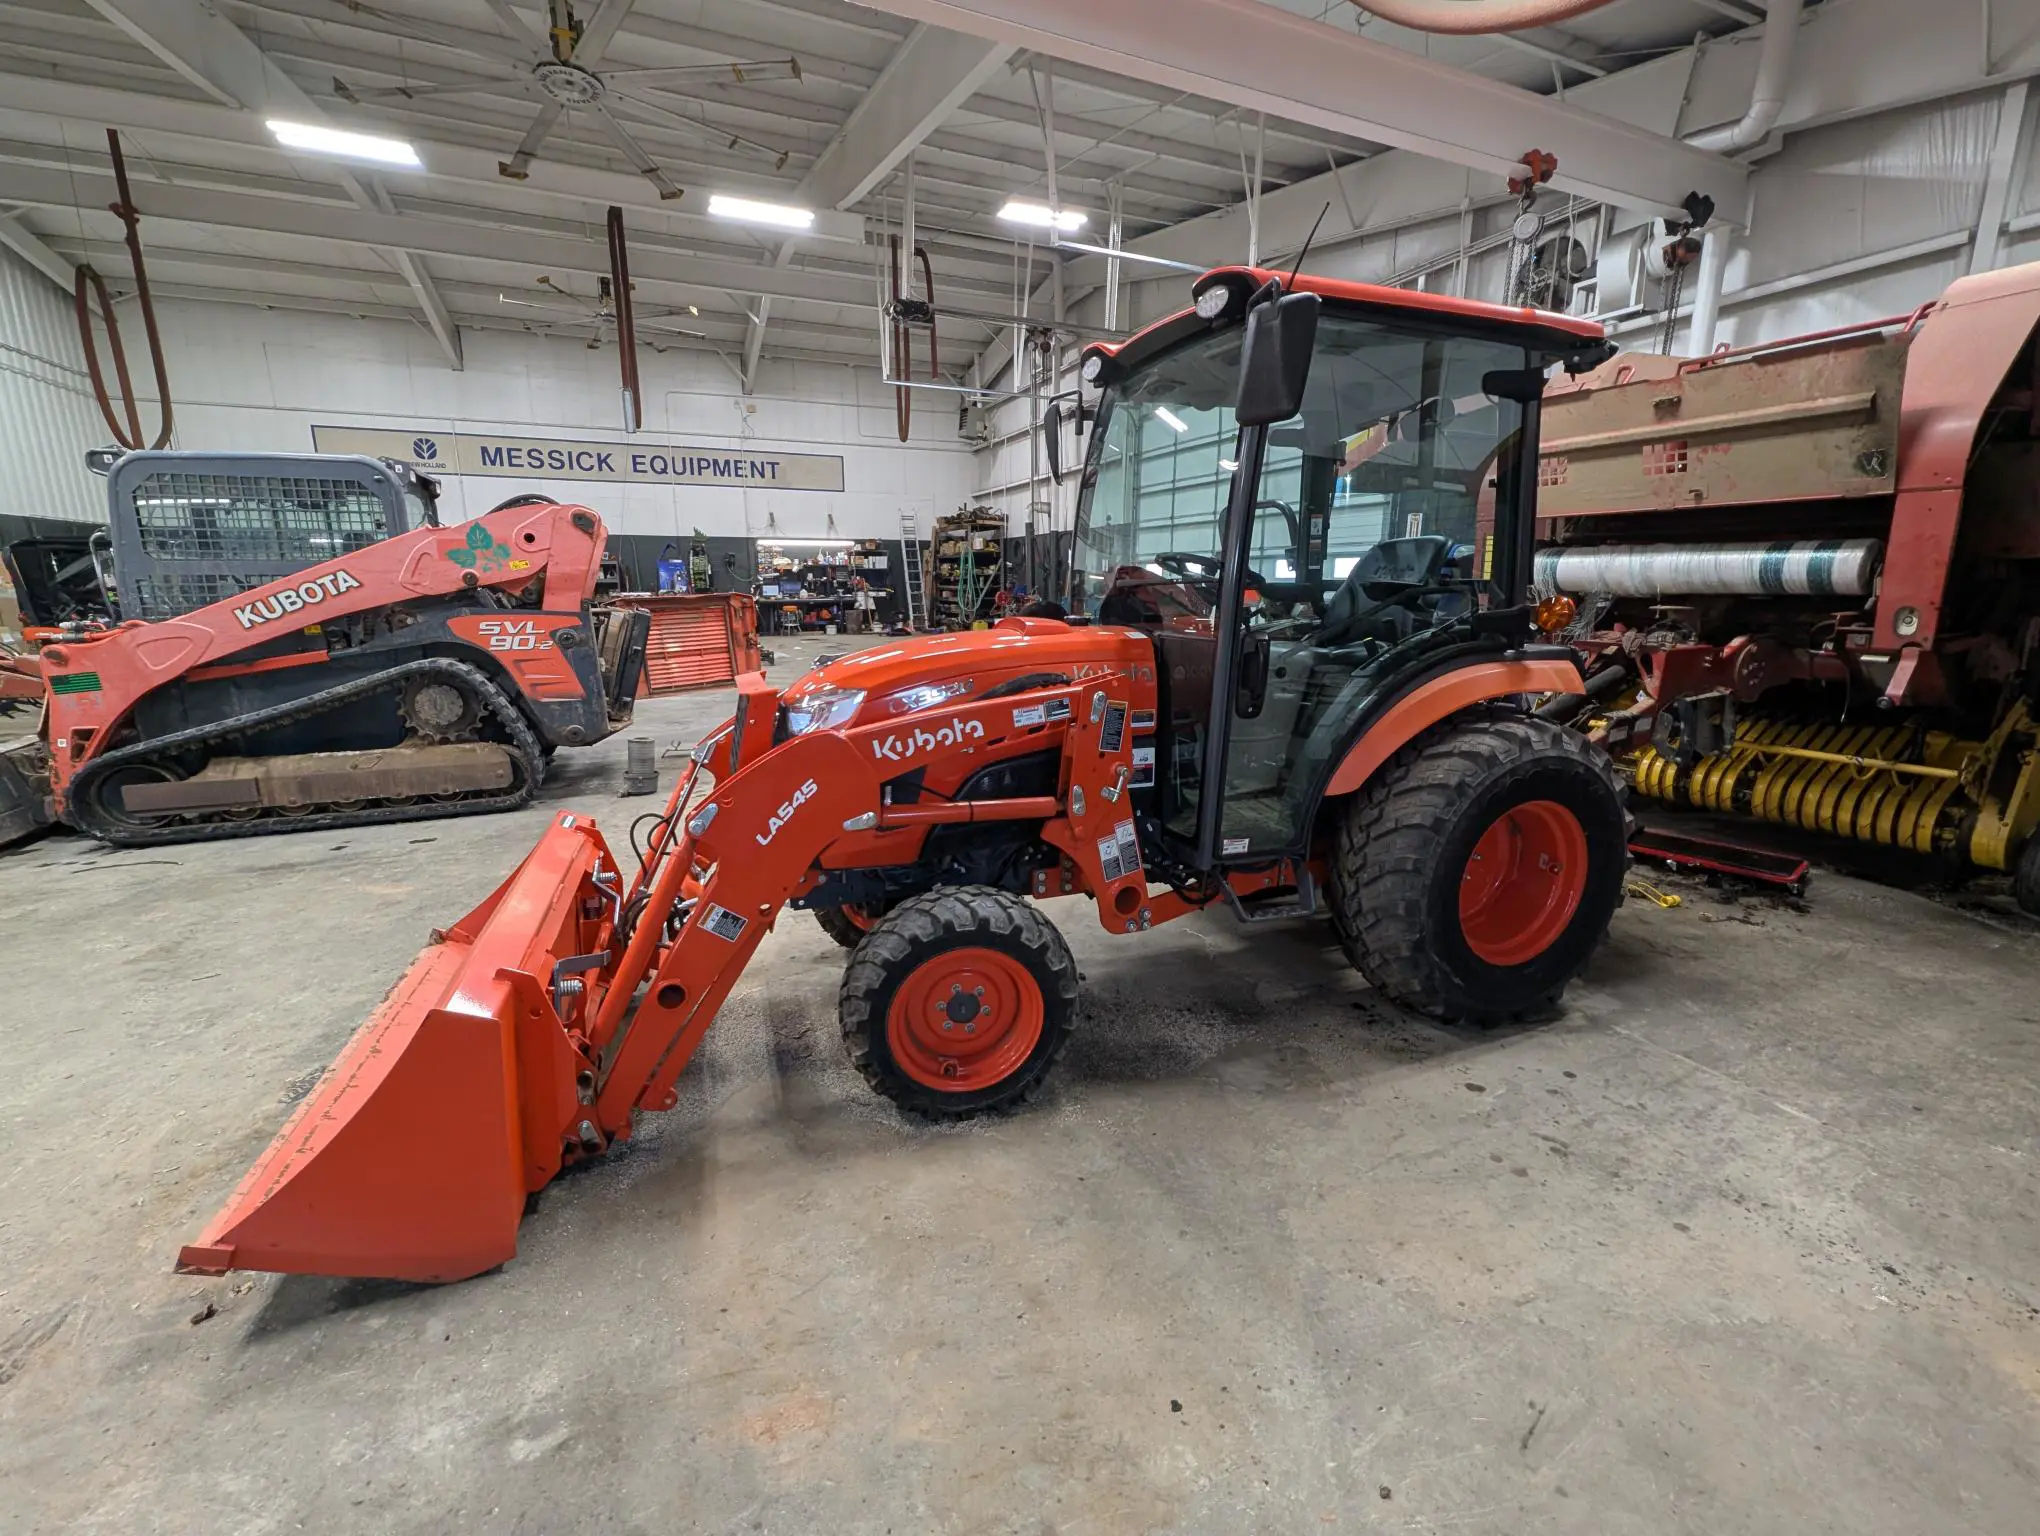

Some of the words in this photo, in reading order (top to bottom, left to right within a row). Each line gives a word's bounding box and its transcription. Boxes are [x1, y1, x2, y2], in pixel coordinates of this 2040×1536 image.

[480, 445, 615, 473] MESSICK
[631, 453, 780, 481] EQUIPMENT
[233, 569, 361, 629] KUBOTA
[479, 621, 545, 635] SVL
[489, 635, 554, 651] 90-2
[872, 718, 985, 761] Kubota
[756, 777, 818, 847] LA545
